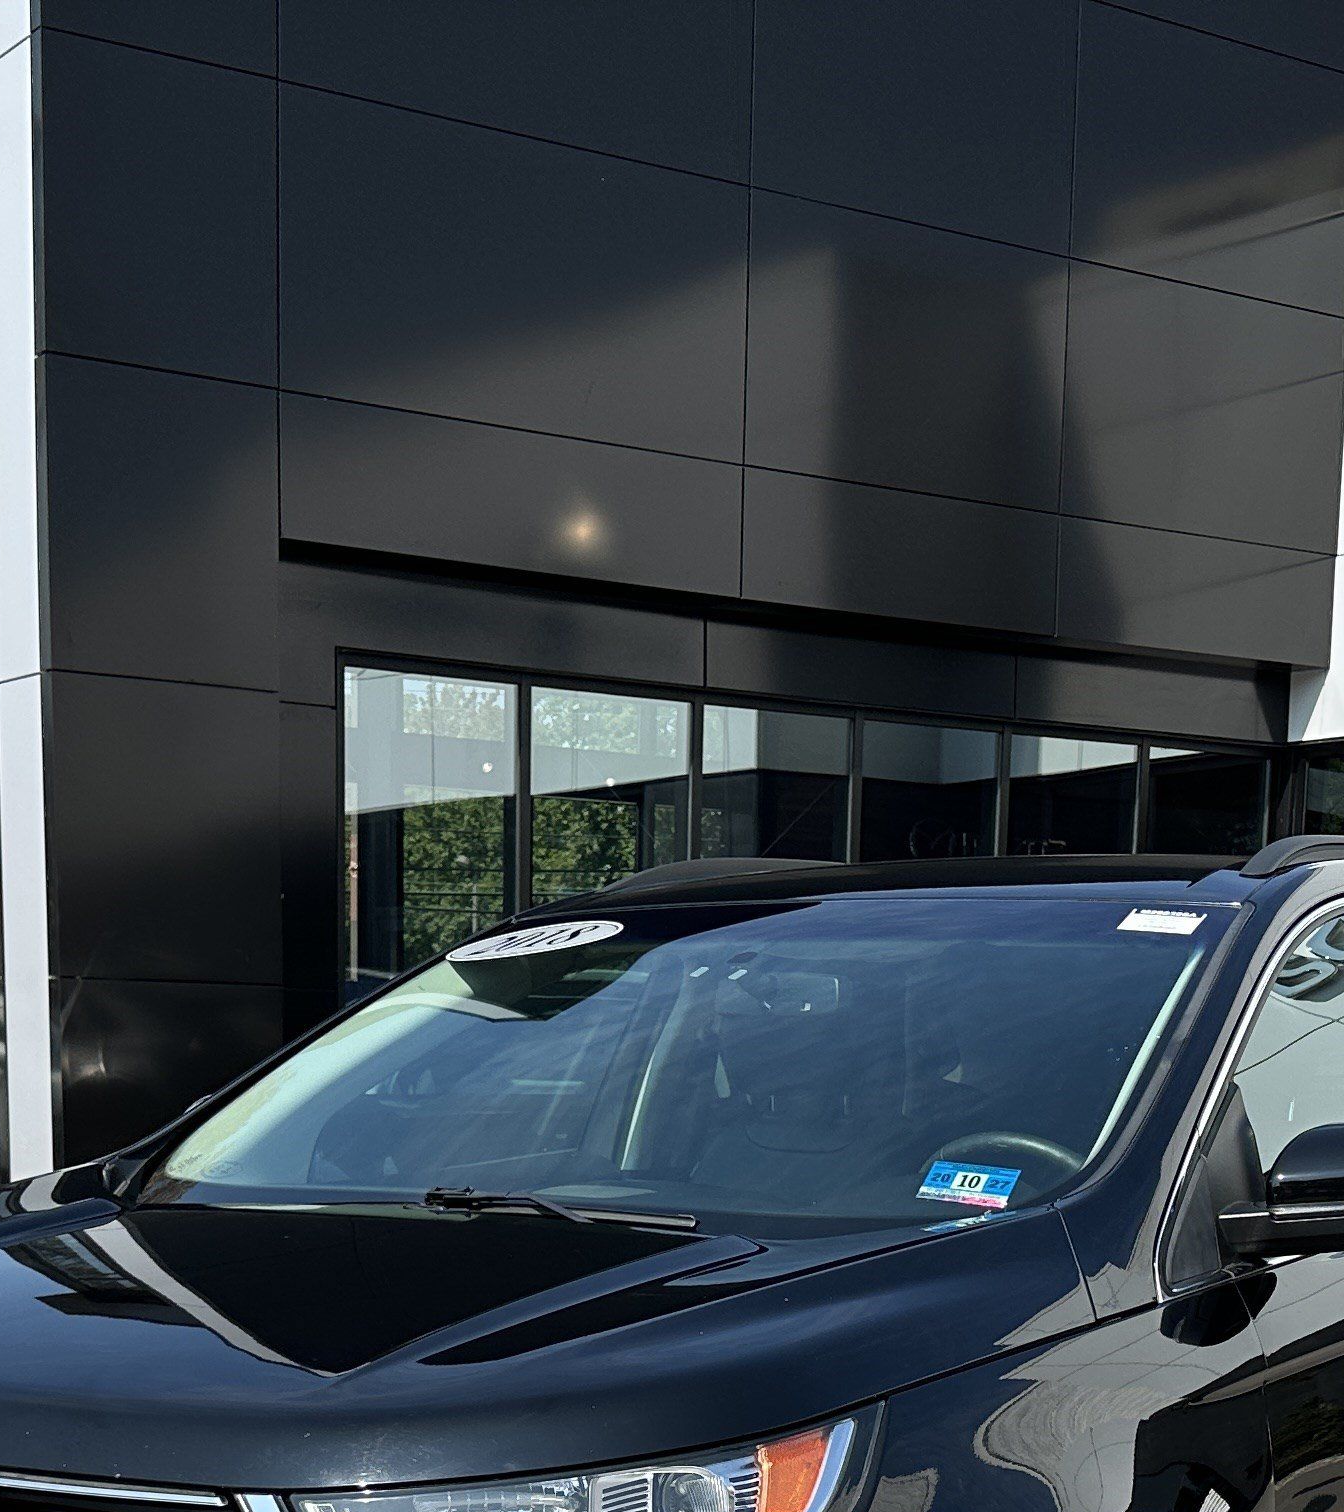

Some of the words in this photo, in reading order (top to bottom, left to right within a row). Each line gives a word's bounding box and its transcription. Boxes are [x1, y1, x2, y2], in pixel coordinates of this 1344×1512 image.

[464, 925, 600, 957] 2018
[931, 1172, 951, 1182] 20
[957, 1174, 981, 1189] 10
